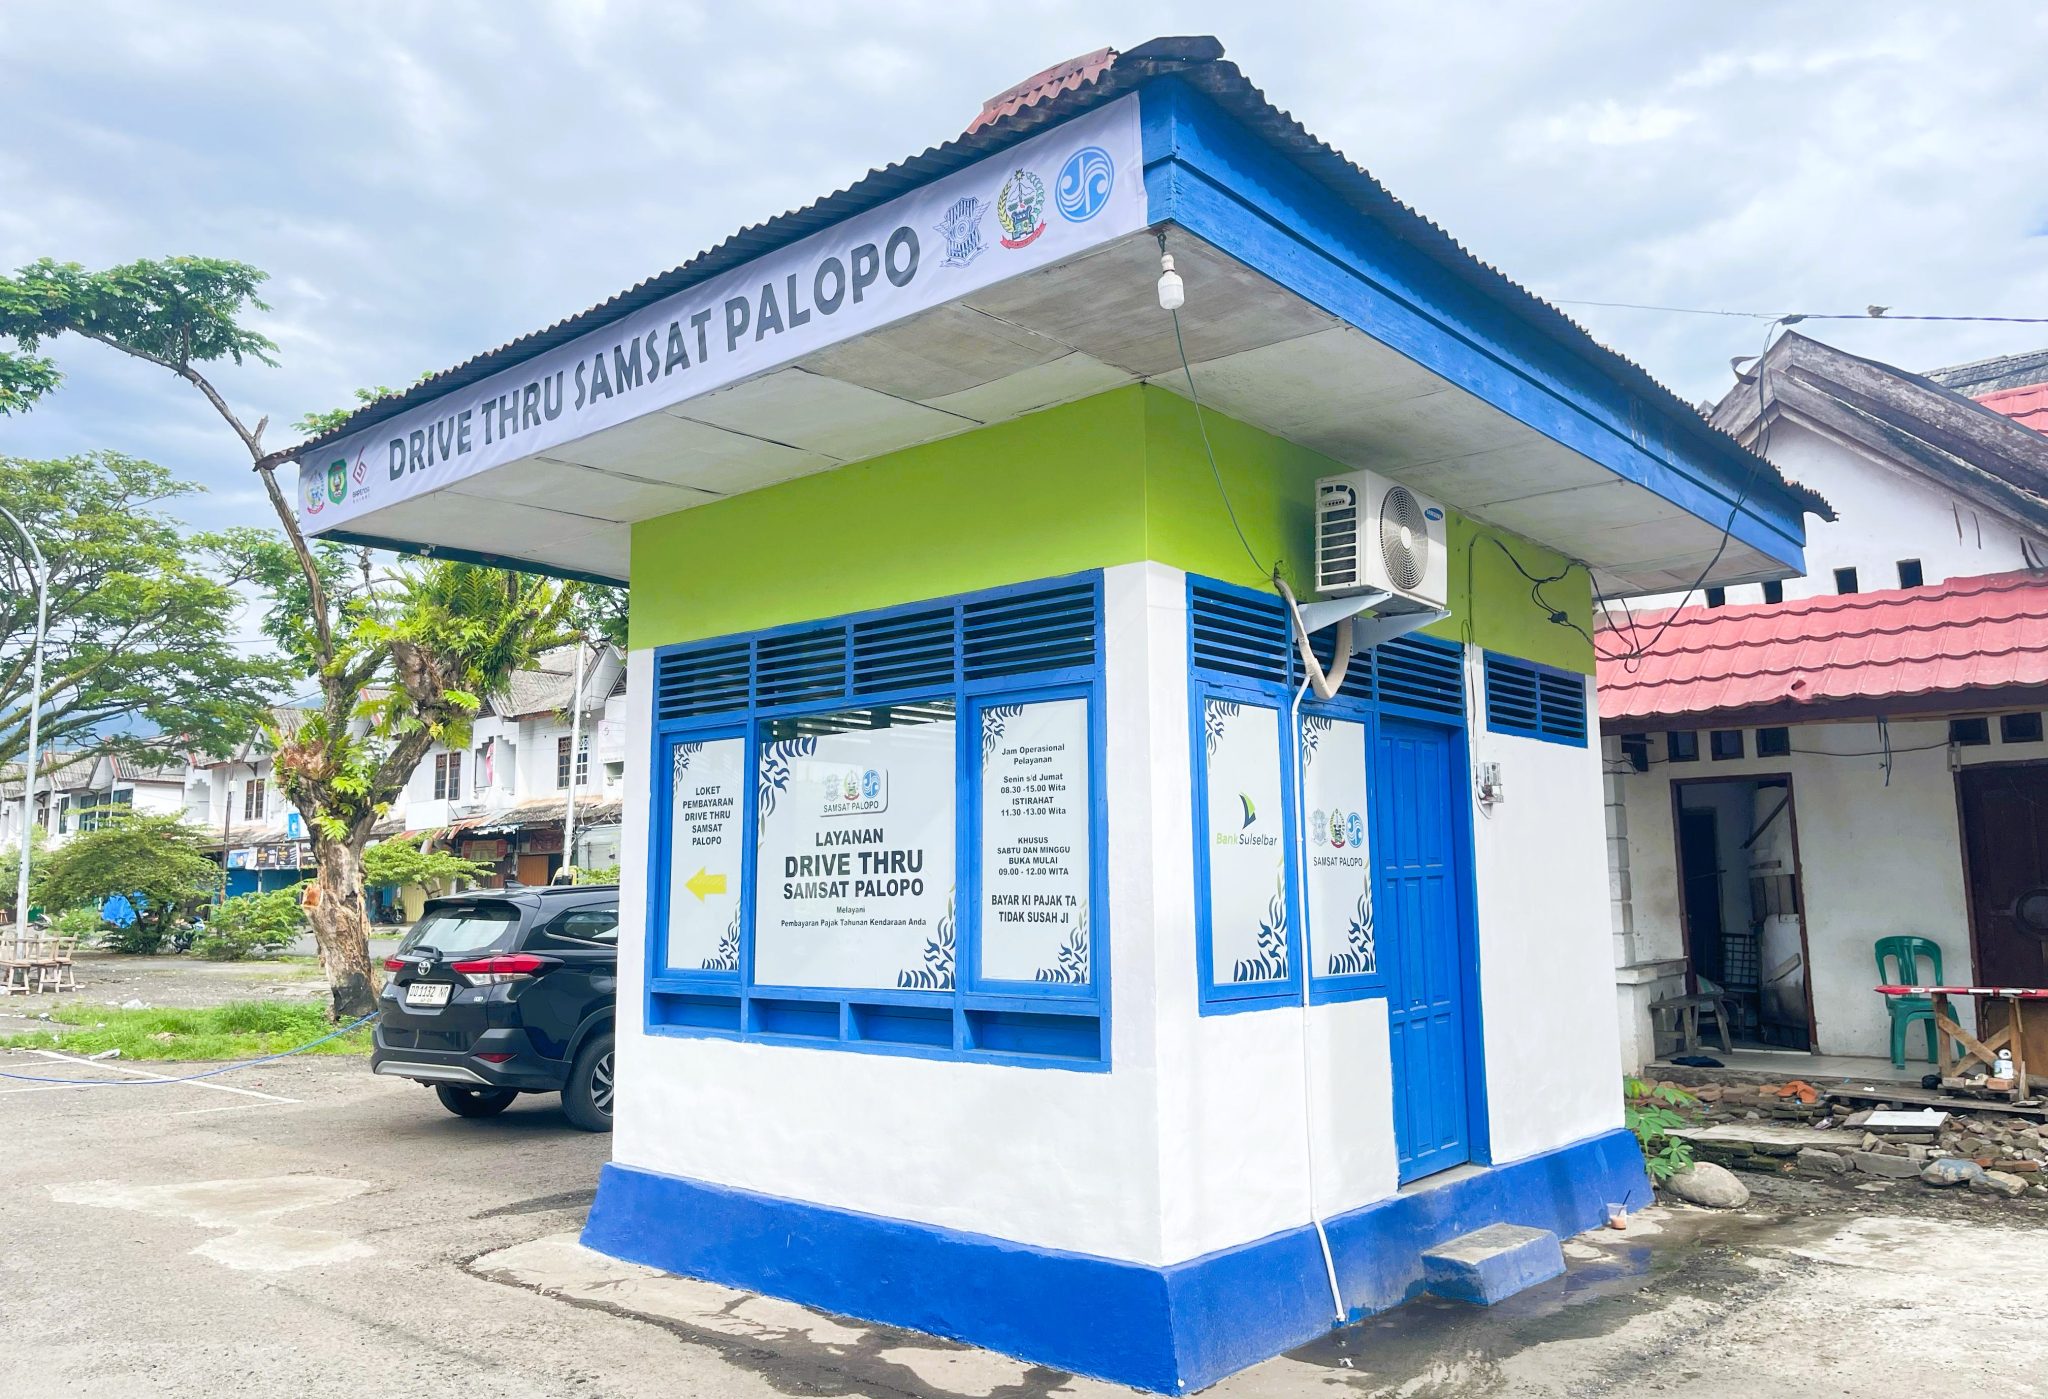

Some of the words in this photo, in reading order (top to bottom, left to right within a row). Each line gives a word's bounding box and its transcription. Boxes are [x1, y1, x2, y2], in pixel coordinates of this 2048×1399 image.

[389, 409, 472, 481] DRIVE
[481, 370, 563, 445] THRU
[574, 308, 711, 411] SAMSAT
[724, 226, 920, 353] PALOPO
[1020, 744, 1064, 755] Operasional
[1014, 757, 1052, 765] Pelayanan
[1039, 773, 1063, 781] Jumat
[696, 786, 720, 795] LOKET
[1001, 786, 1021, 794] 08.30
[683, 798, 734, 809] PEMBAYARAN
[1013, 797, 1054, 805] ISTIRAHAT
[824, 803, 850, 813] SAMSAT
[852, 801, 879, 810] PALOPO
[685, 812, 707, 821] DRIVE
[710, 811, 731, 819] THRU
[692, 824, 722, 833] SAMSAT
[692, 837, 722, 846] PALOPO
[816, 828, 883, 846] LAYANAN
[1216, 833, 1238, 845] Bank
[1239, 834, 1277, 846] Sulselbar
[786, 853, 850, 878] DRIVE
[858, 850, 923, 874] THRU
[1314, 857, 1338, 867] SAMSAT
[1340, 858, 1363, 867] PALOPO
[784, 881, 849, 900] SAMSAT
[855, 879, 924, 897] PALOPO
[992, 895, 1019, 906] BAYAR
[1022, 895, 1031, 905] KI
[1034, 895, 1062, 906] PAJAK
[1065, 896, 1077, 906] TA
[837, 906, 866, 915] Melayani
[781, 920, 819, 928] Pembayaran
[821, 919, 838, 928] Pajak
[909, 918, 927, 926] Anda
[999, 912, 1025, 922] TIDAK
[1028, 912, 1057, 923] SUSAH
[1061, 912, 1069, 924] JI
